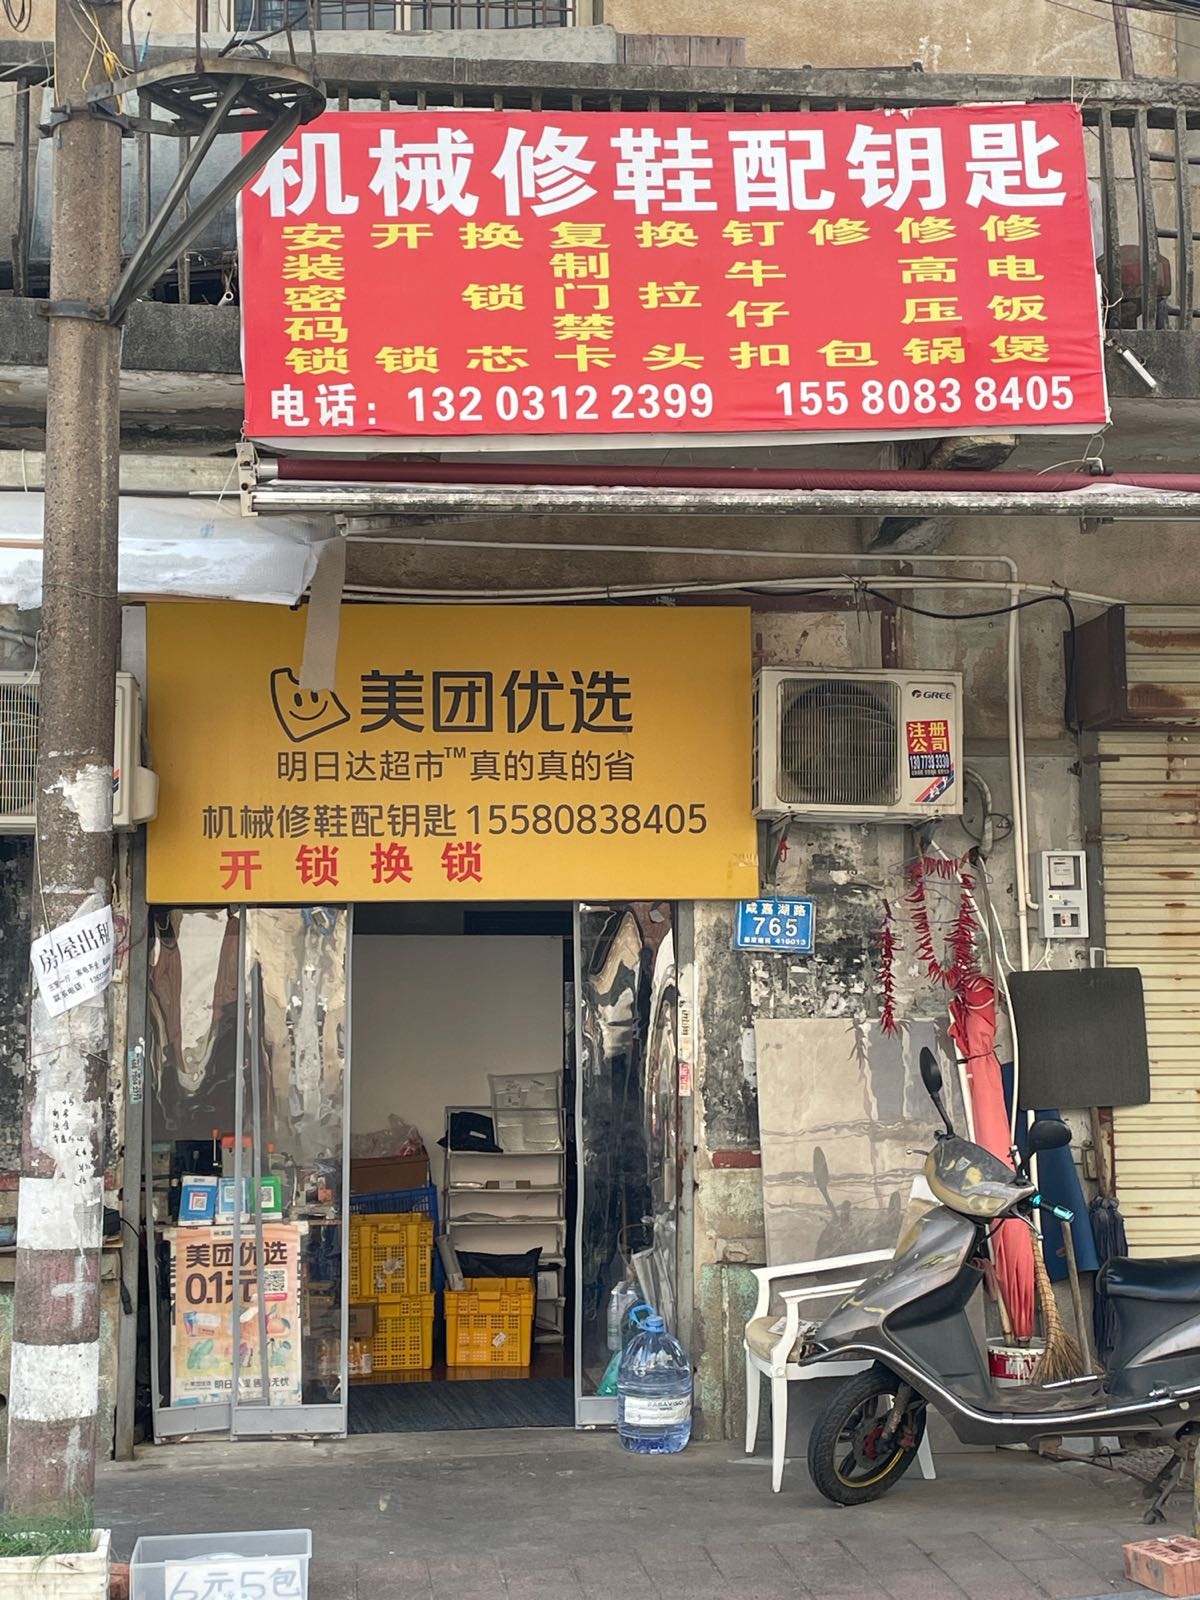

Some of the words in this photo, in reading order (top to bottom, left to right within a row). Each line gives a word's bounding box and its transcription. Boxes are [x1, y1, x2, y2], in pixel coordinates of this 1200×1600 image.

[251, 120, 1067, 217] 机械修鞋配钥匙
[360, 669, 633, 734] 美团优选
[923, 691, 953, 700] GREE
[39, 921, 111, 974] 房屋出租
[753, 916, 798, 937] 765
